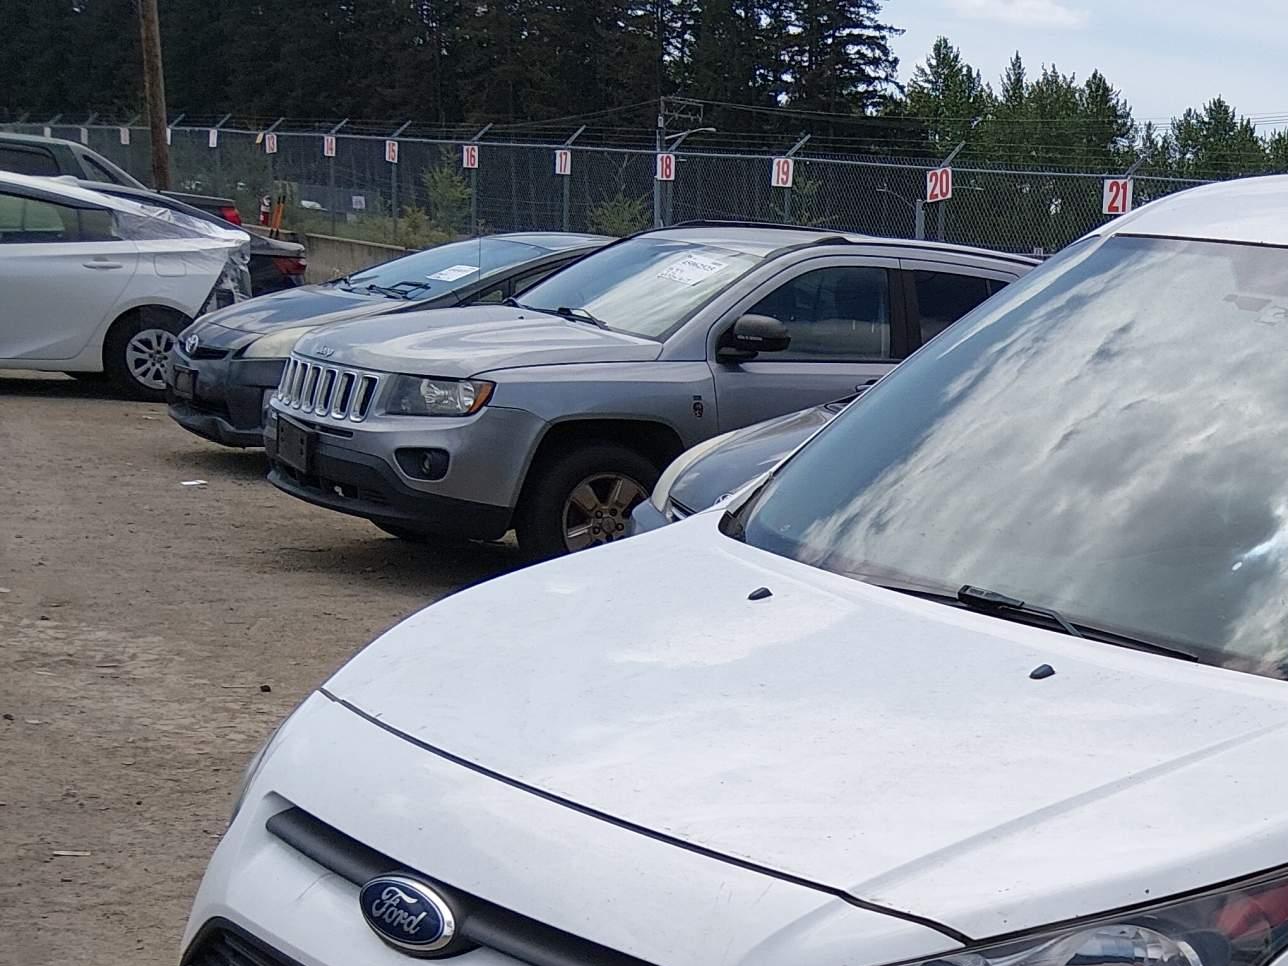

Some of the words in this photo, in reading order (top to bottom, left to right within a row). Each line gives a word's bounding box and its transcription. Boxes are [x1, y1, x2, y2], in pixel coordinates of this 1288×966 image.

[326, 136, 335, 155] 14
[388, 142, 397, 161] 15
[465, 147, 476, 167] 16
[559, 151, 568, 173] 17
[660, 155, 672, 179] 18
[775, 159, 790, 186] 19
[929, 168, 950, 201] 20
[1107, 180, 1128, 213] 21
[371, 886, 428, 934] Ford
